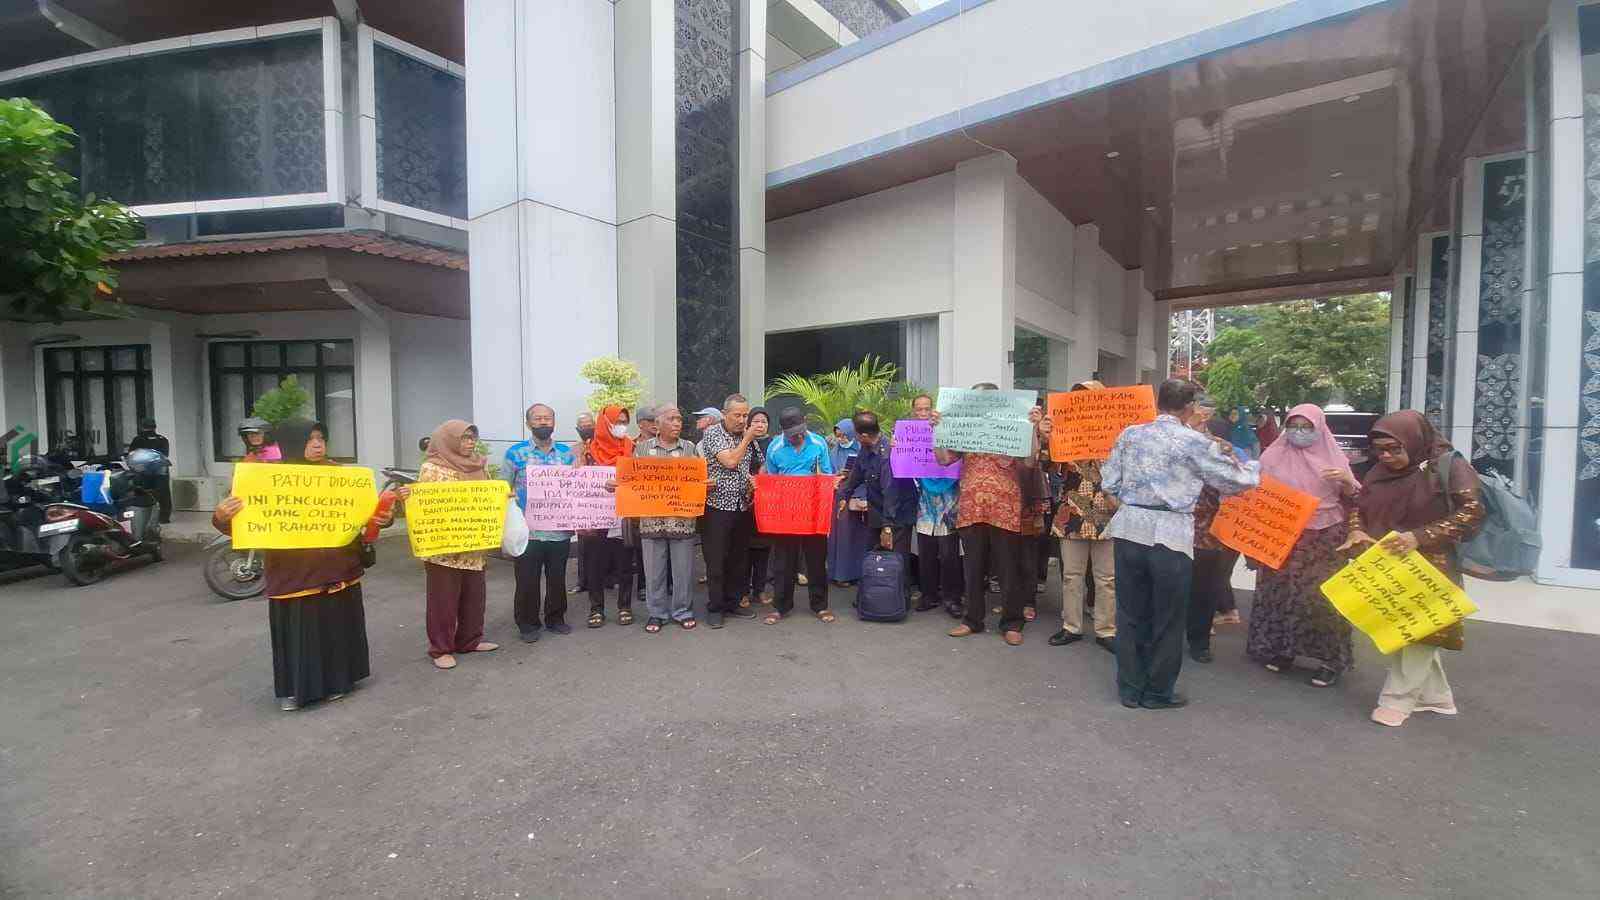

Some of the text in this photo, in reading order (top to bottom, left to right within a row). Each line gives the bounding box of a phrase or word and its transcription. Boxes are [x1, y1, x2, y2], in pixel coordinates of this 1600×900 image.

[271, 473, 372, 489] PATUT DIDUGA
[247, 494, 354, 507] INI PENCUCIAN
[308, 509, 347, 518] OLEH
[247, 521, 273, 533] DWI
[279, 521, 335, 532] RAHAYU
